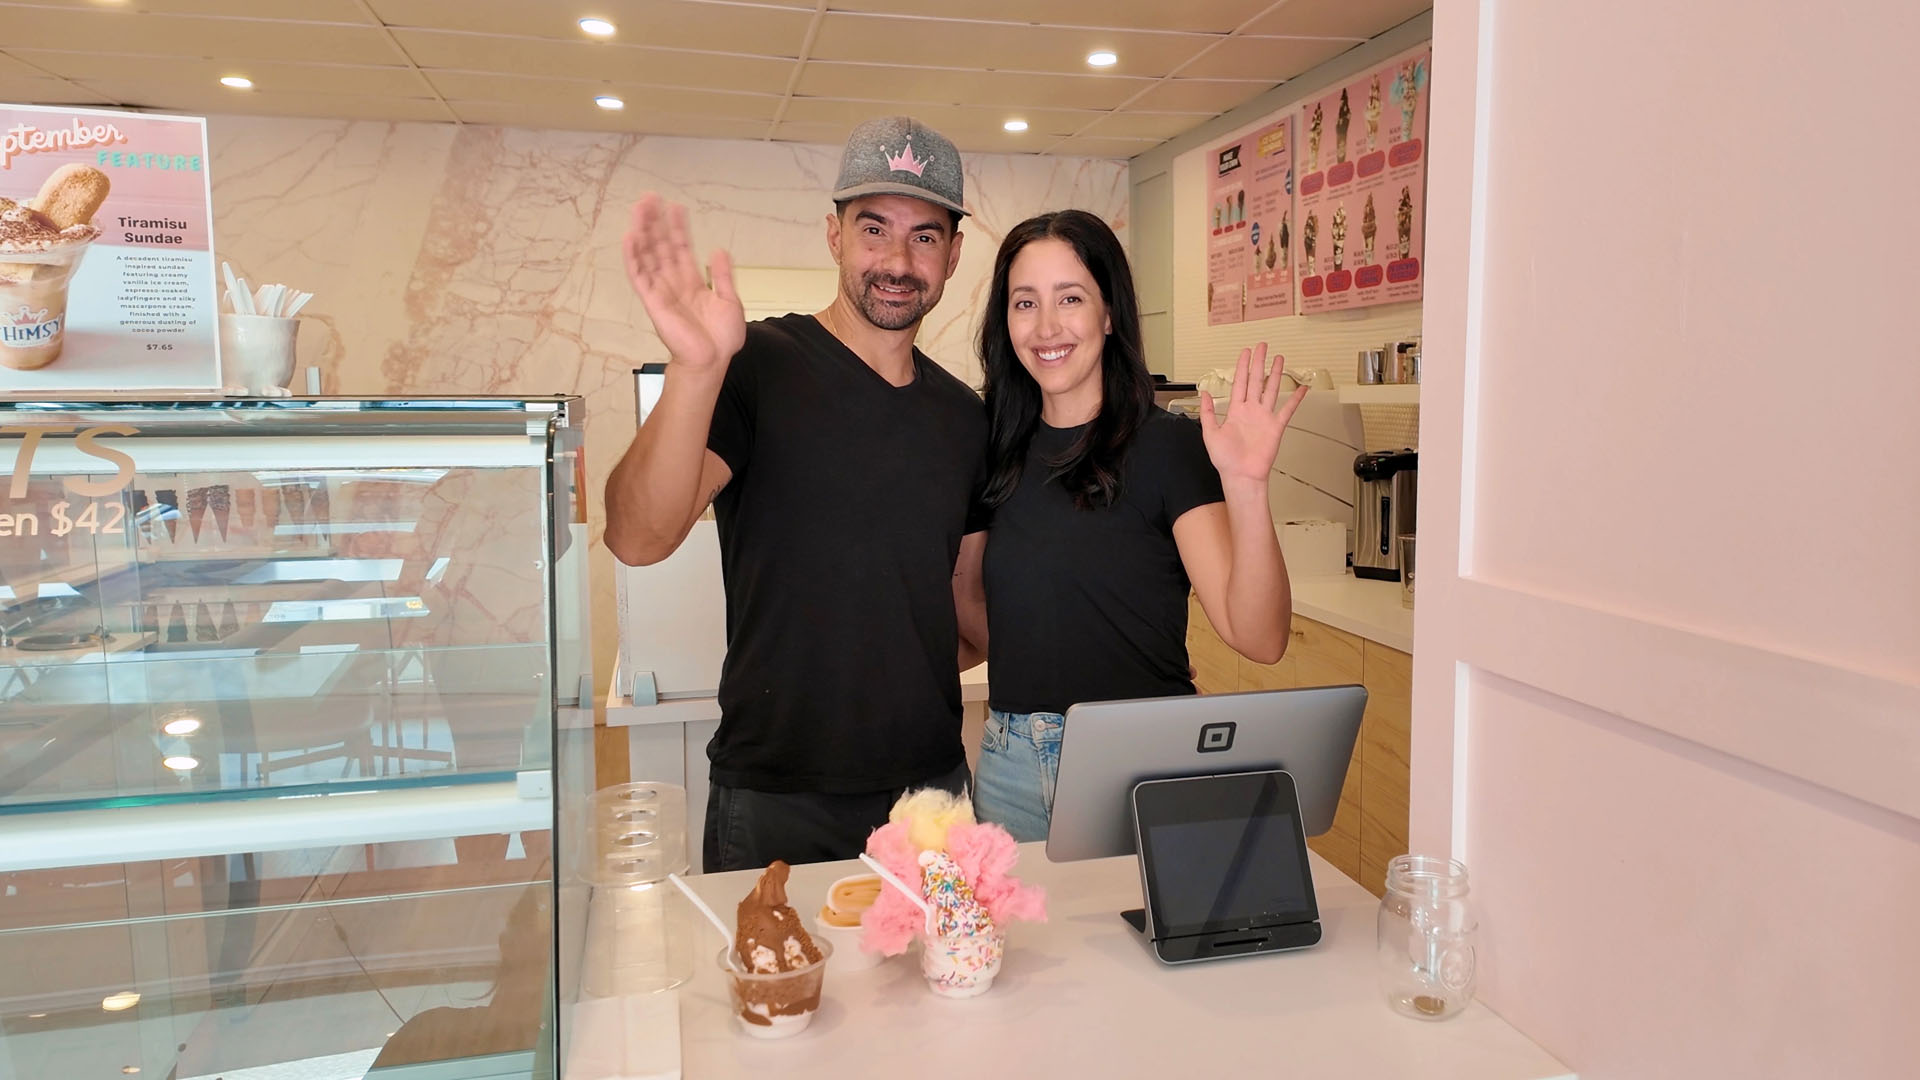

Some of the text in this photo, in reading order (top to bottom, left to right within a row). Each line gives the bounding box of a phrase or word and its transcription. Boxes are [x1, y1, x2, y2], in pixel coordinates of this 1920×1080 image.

[96, 150, 201, 171] FEATURE
[117, 216, 188, 230] Tiramisu
[124, 232, 183, 244] Sundae
[0, 320, 59, 341] HIMSY
[50, 501, 126, 537] $42
